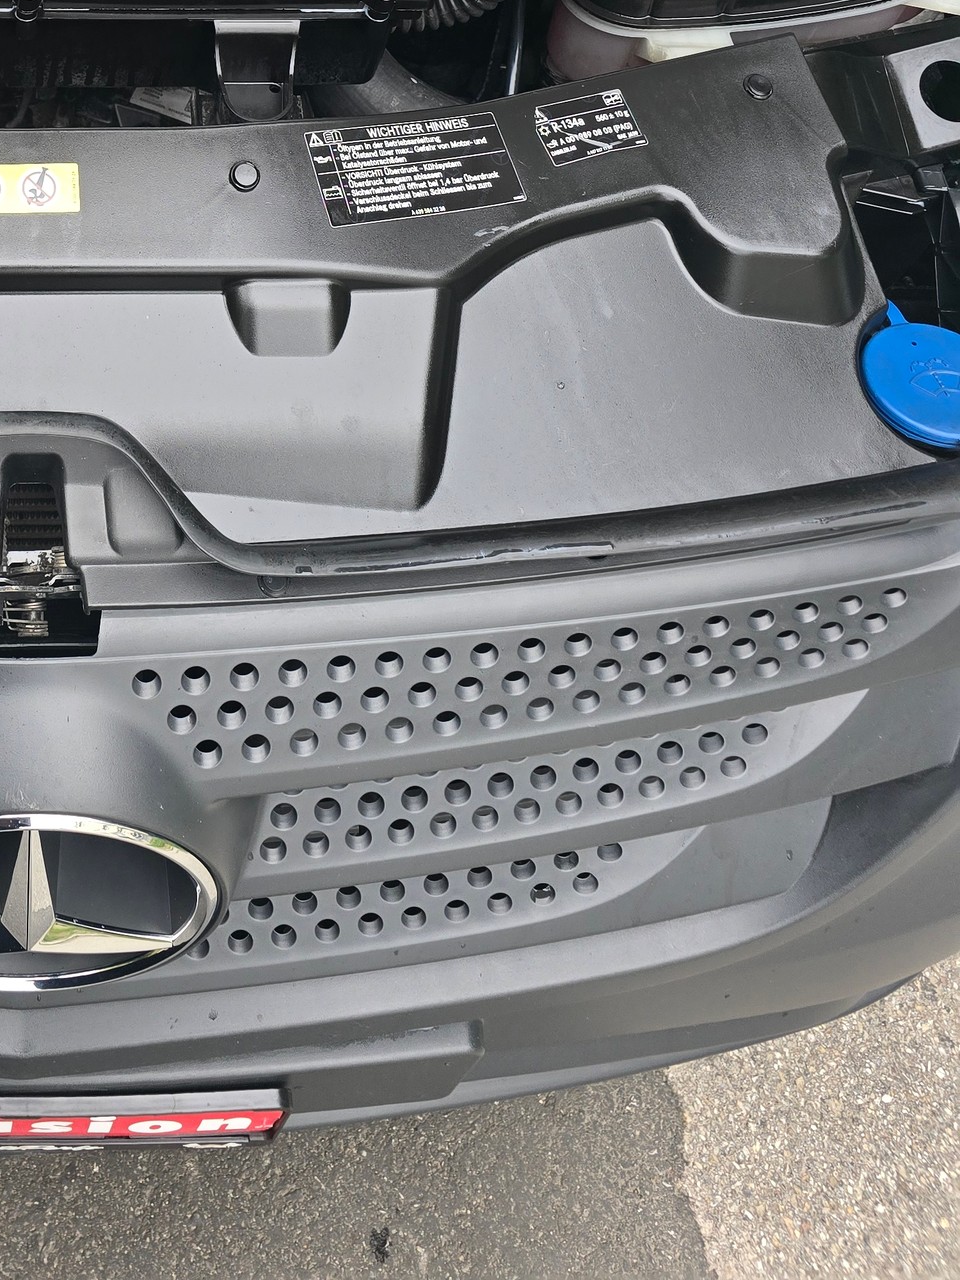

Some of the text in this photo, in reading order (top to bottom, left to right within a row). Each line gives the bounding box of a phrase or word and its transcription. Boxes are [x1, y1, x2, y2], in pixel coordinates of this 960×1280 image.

[366, 118, 469, 138] WICHTIGER HINWEIS
[551, 118, 585, 132] R-134a
[337, 143, 364, 153] Öltypen
[372, 141, 383, 149] der
[384, 136, 441, 148] Betriebsanleitung
[340, 153, 351, 161] Bei
[352, 150, 378, 159] Ölstand
[379, 148, 394, 157] über
[414, 144, 436, 153] Gefahr
[437, 142, 450, 150] von
[473, 137, 487, 145] und
[560, 138, 566, 146] A
[342, 156, 407, 169] Katalysatorschäden
[383, 166, 420, 176] Überdruck
[423, 160, 462, 171] Kühlsystem
[348, 171, 443, 189] Überdruck langsam ablassen
[351, 183, 406, 197] Sicherheitsventil
[427, 179, 438, 187] bei
[440, 178, 451, 186] 1,4
[451, 176, 463, 184] bar
[463, 171, 500, 182] Überdruck
[353, 181, 492, 205] Verschlussdeckel beim Schliessen bis zum
[357, 201, 412, 213] Anschlag drehen
